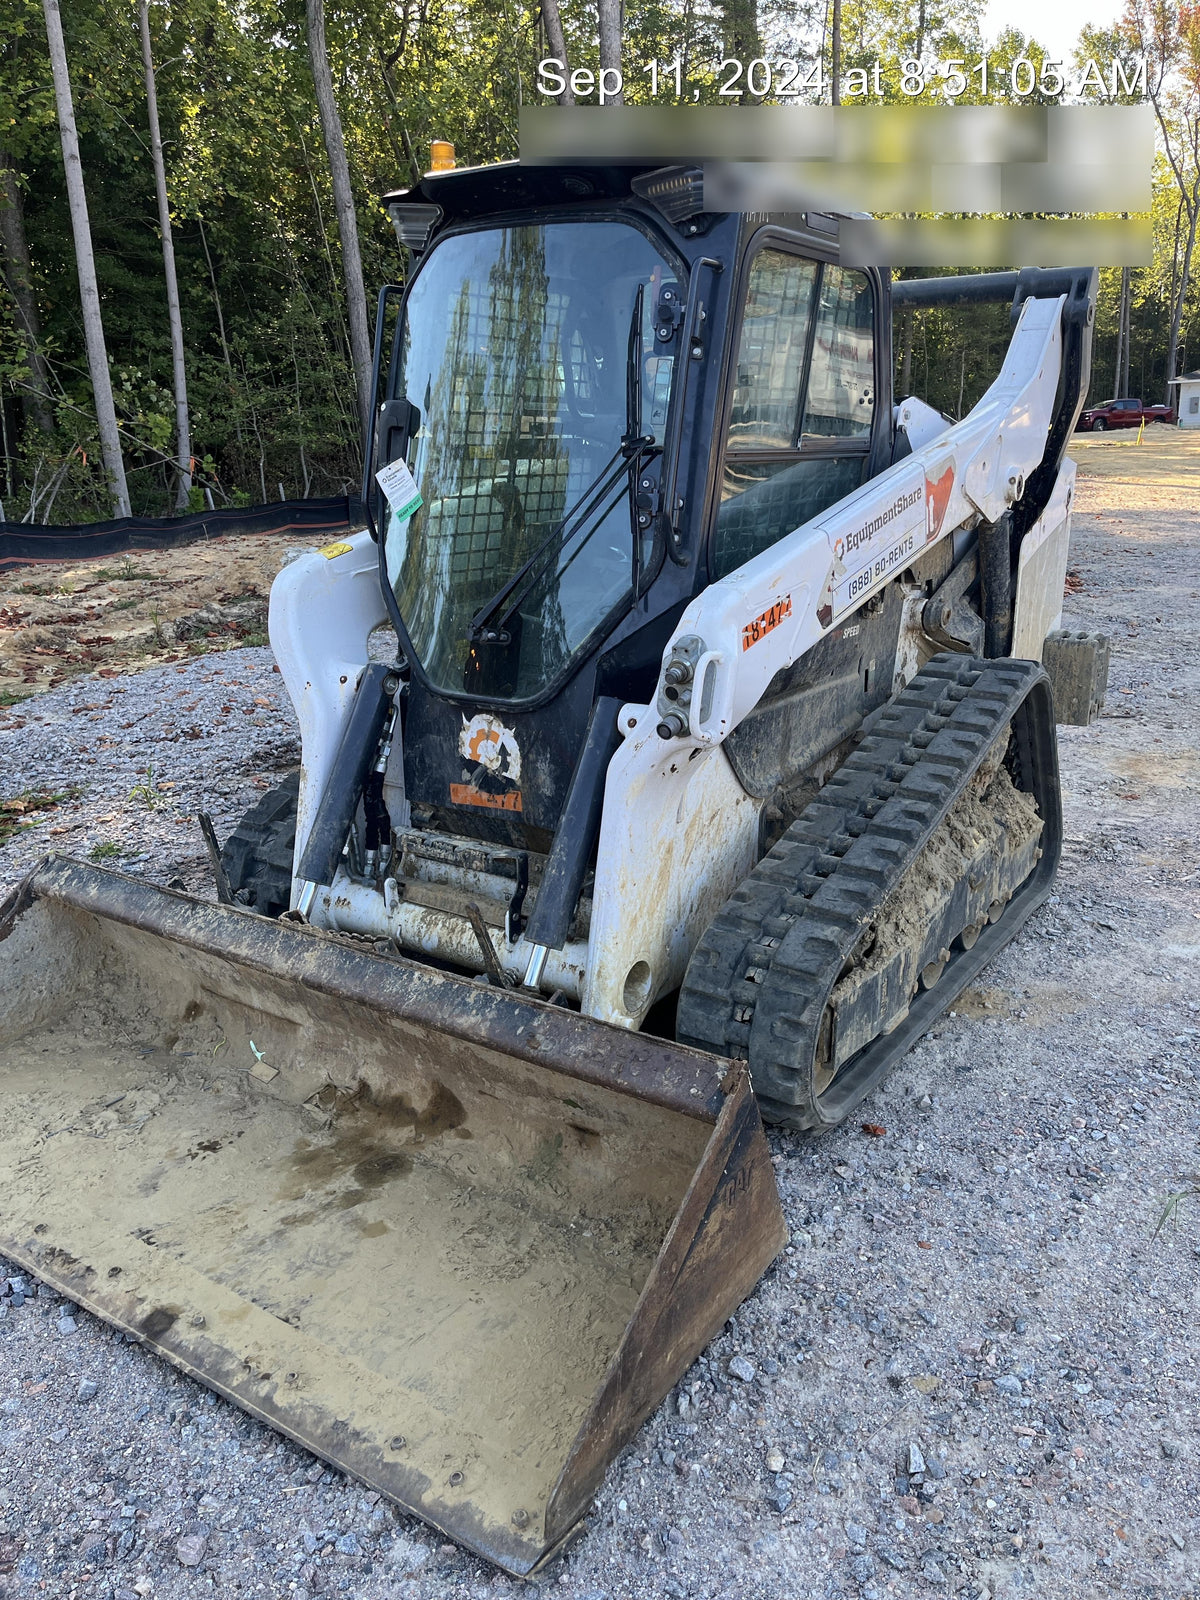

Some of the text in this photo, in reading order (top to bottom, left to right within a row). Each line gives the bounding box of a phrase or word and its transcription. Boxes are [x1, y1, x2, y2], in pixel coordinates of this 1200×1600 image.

[846, 487, 922, 552] EquipmentShare
[848, 536, 913, 599] (888) 80-RENTS
[842, 624, 860, 640] SPEED
